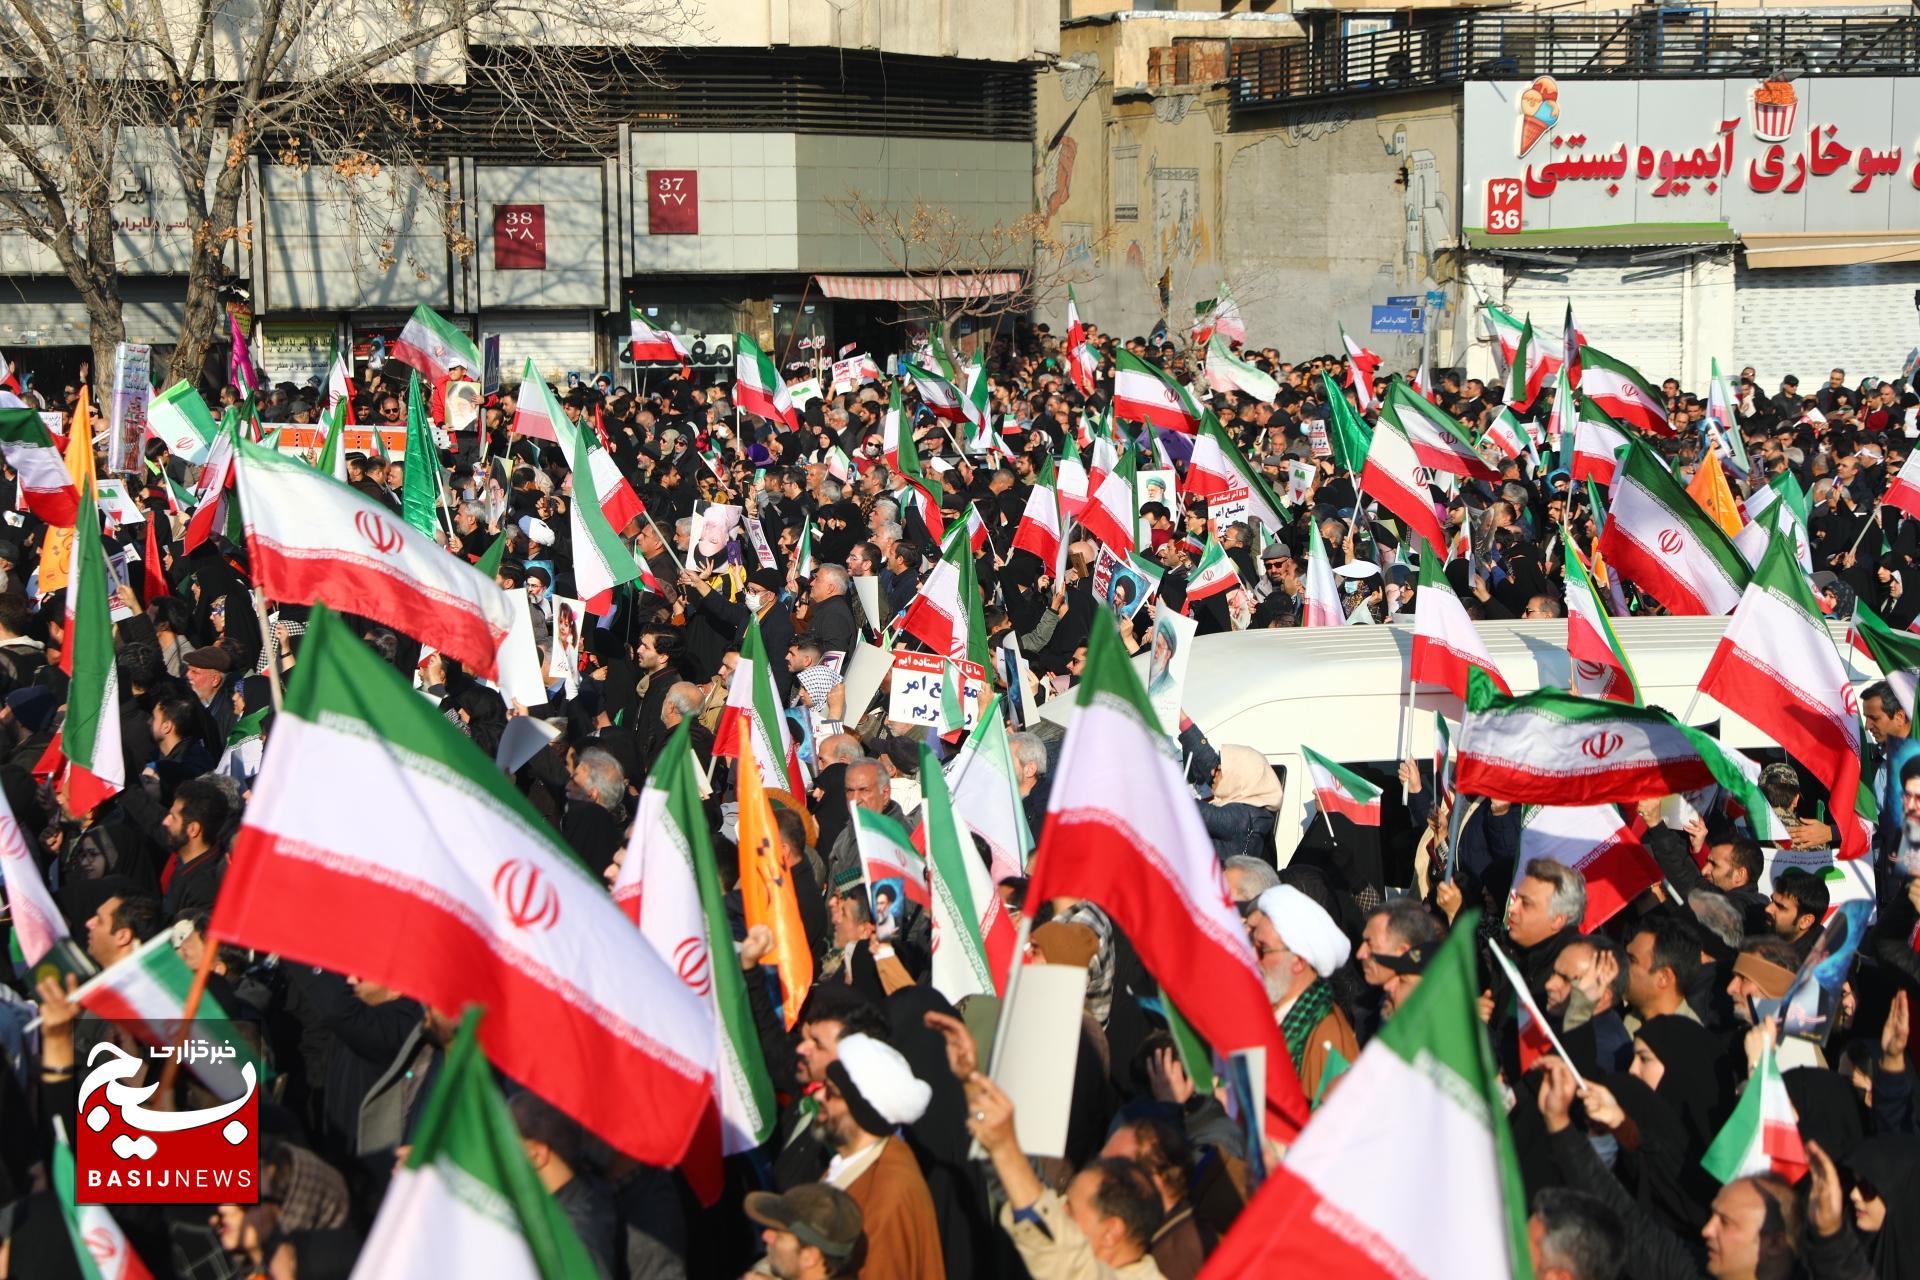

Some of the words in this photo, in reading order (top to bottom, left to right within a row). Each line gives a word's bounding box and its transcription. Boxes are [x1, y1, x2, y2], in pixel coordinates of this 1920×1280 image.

[1636, 117, 1742, 197] آبمیوه
[1749, 123, 1902, 193] سوخاری
[1525, 133, 1628, 198] بستنی
[659, 177, 684, 191] 37
[658, 193, 687, 206] ۳۷
[1492, 183, 1519, 205] ۳۶
[506, 212, 533, 225] 38
[1490, 209, 1520, 229] 36
[505, 227, 534, 240] ۳۸
[1375, 316, 1392, 325] اسلامی
[1392, 316, 1407, 325] انقلاب
[620, 334, 732, 365] مقه
[1215, 506, 1224, 519] امر
[1225, 502, 1245, 518] مطیع
[898, 656, 911, 667] ایم
[913, 658, 945, 671] ایستاده
[965, 664, 973, 673] تا
[973, 667, 981, 675] ما
[902, 675, 927, 695] امر
